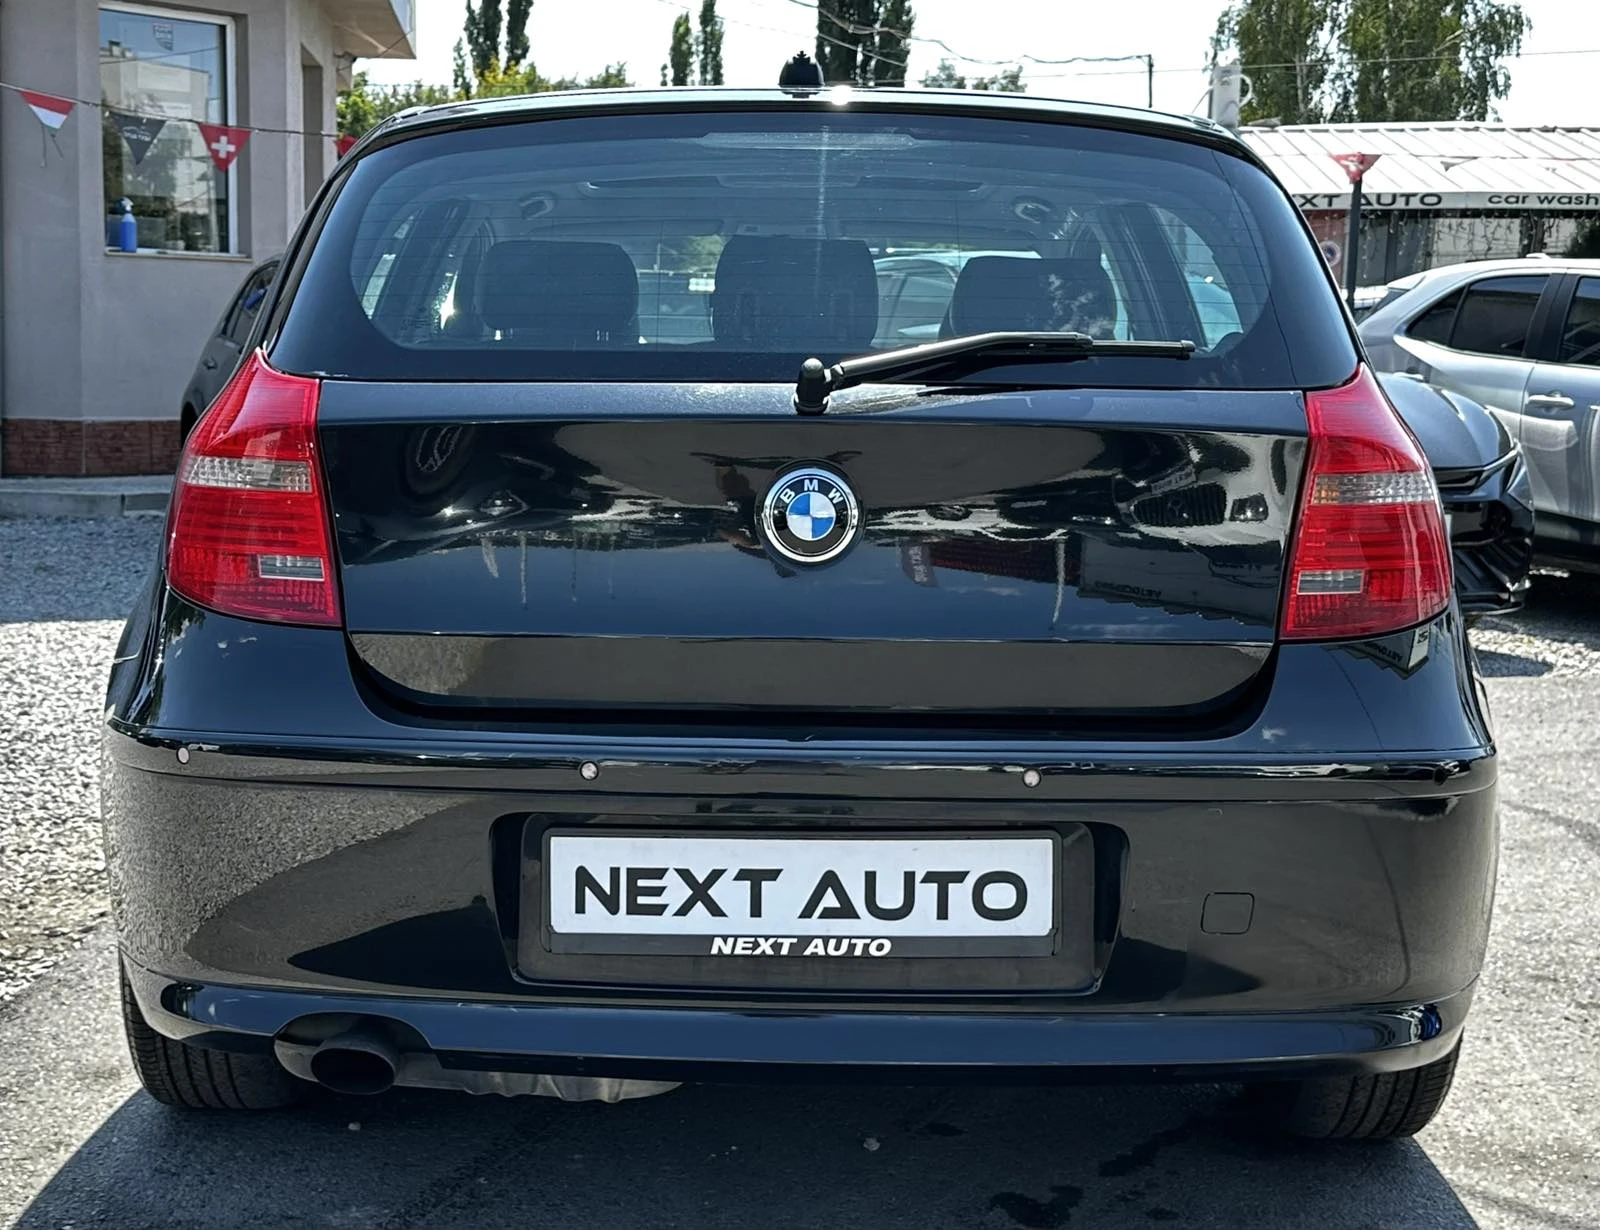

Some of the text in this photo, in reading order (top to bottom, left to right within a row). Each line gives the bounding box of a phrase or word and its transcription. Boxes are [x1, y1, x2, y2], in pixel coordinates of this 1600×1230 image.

[1488, 194, 1599, 206] car wash
[780, 480, 843, 504] BMW
[575, 865, 1028, 921] NEXT AUTO
[710, 937, 892, 956] NEXT AUTO
